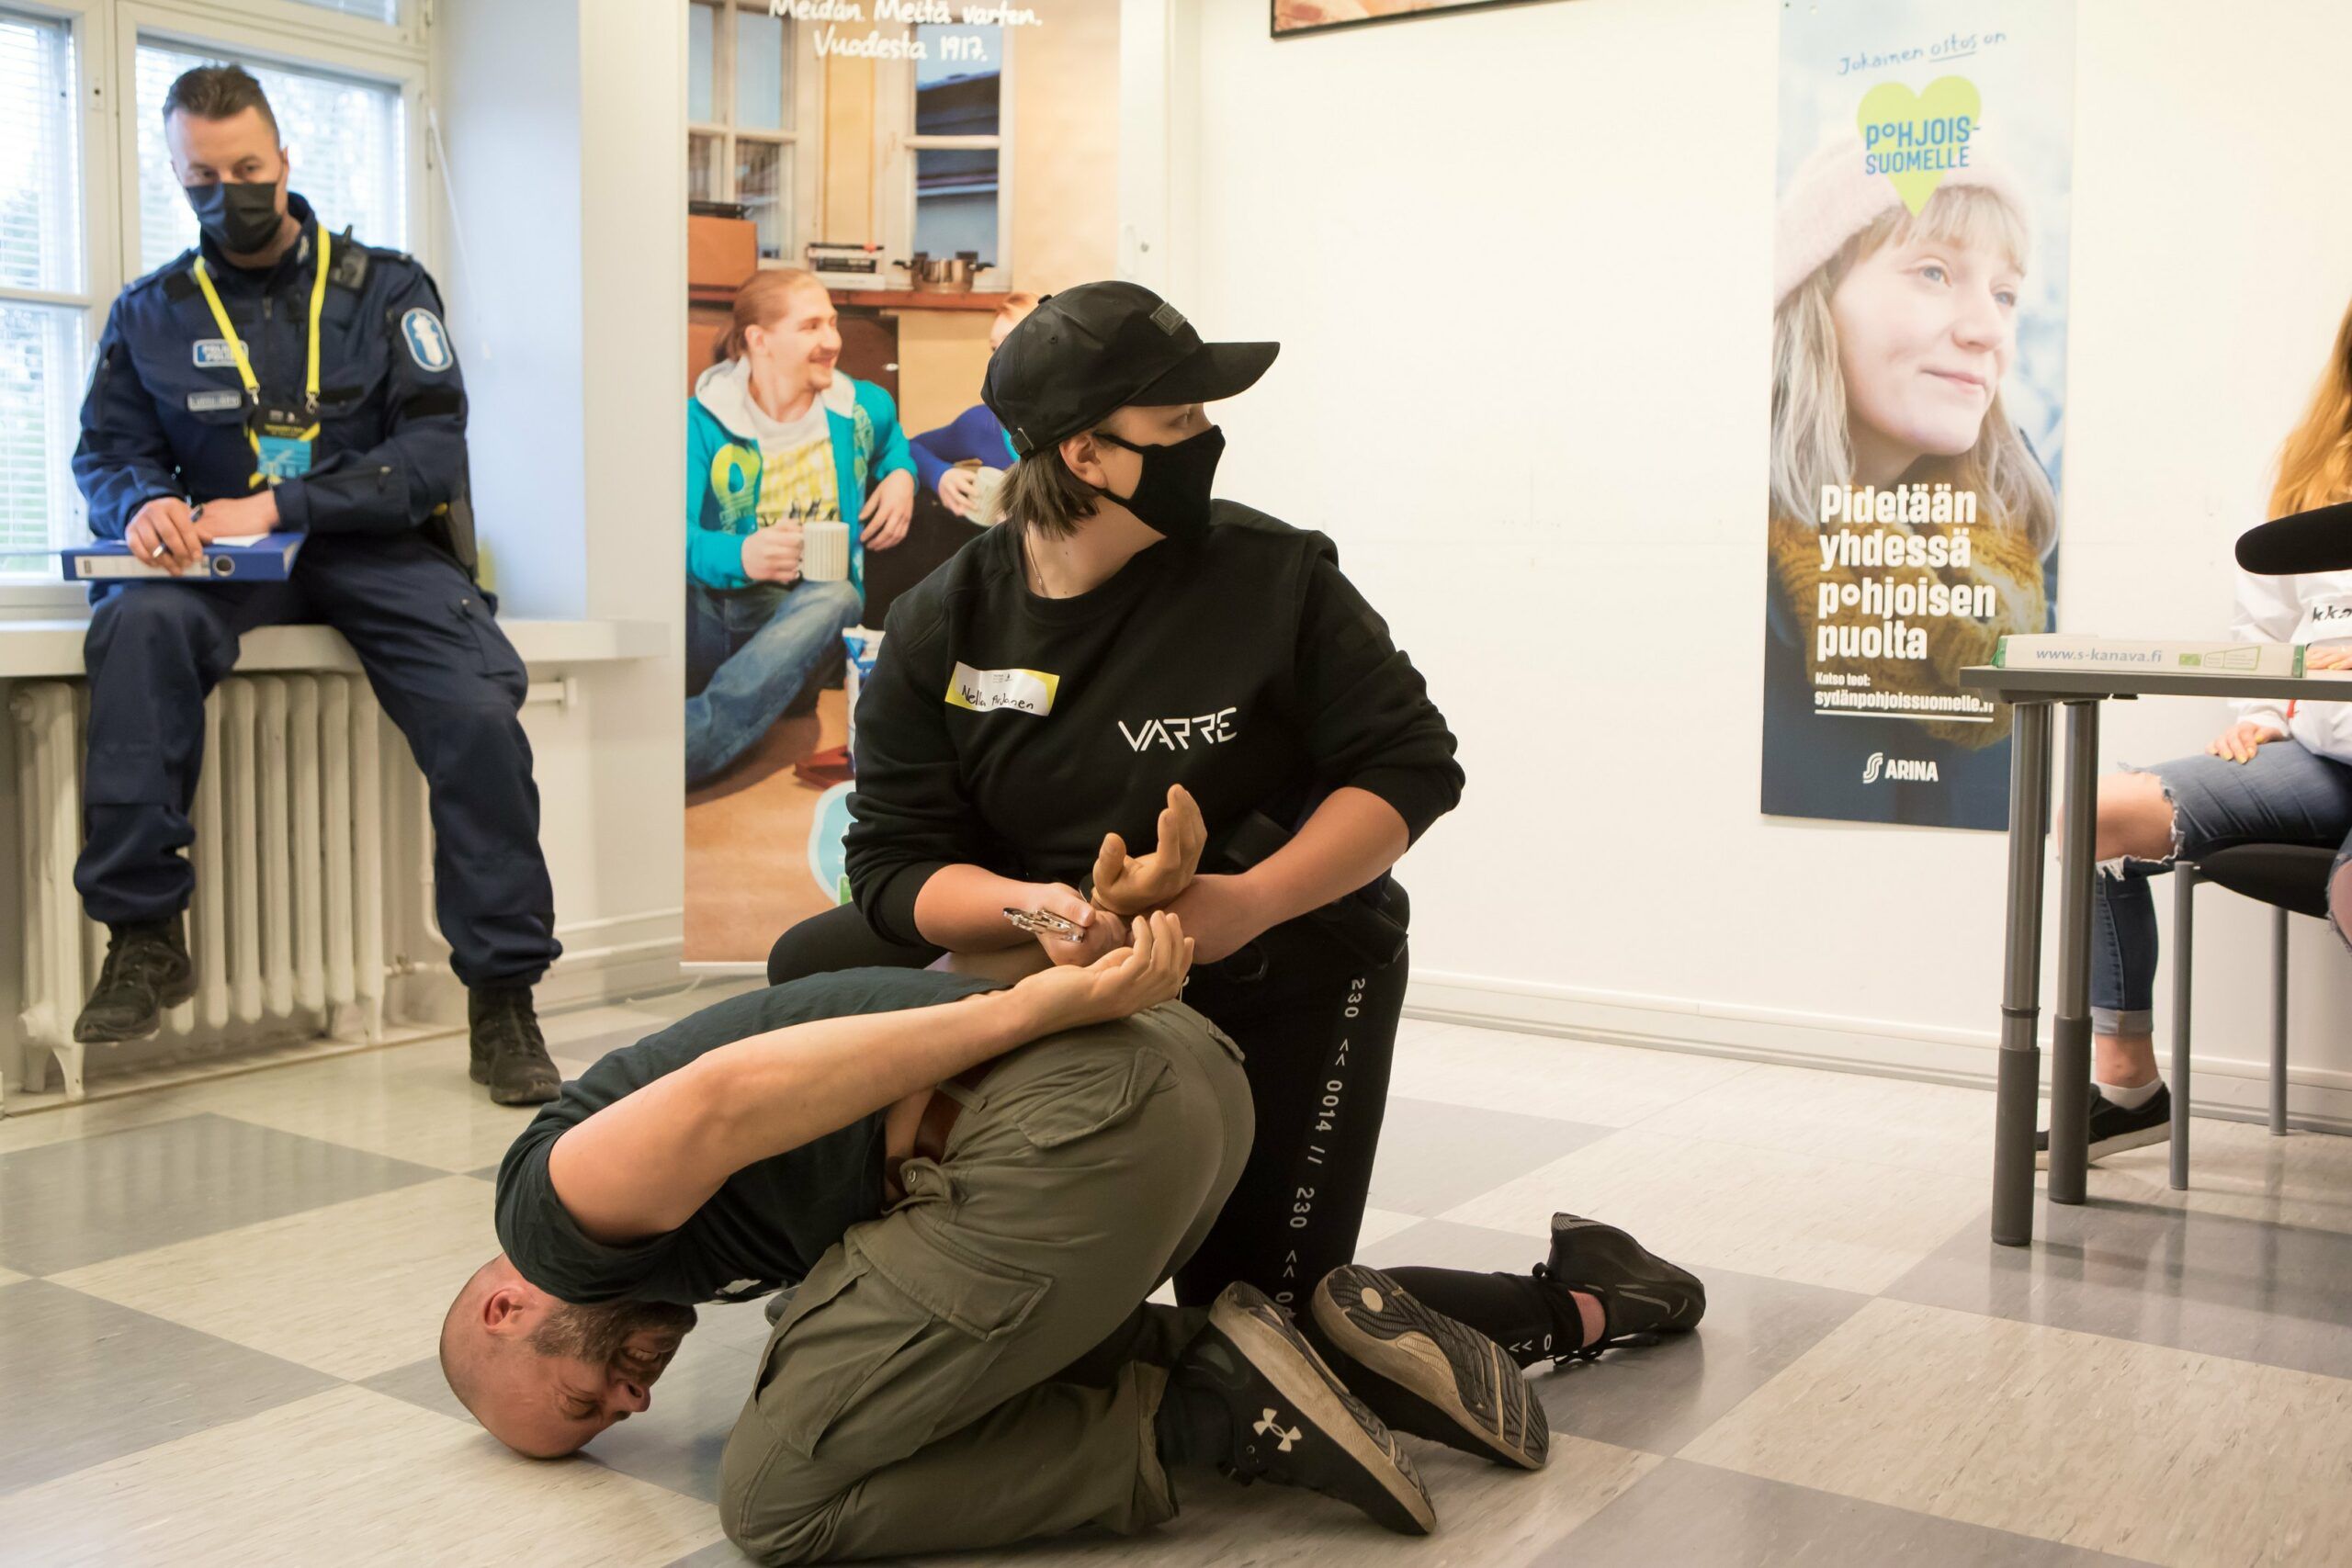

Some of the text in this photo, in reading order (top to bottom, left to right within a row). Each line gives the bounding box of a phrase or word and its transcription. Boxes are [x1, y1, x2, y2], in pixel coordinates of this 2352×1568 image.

[962, 0, 1043, 28] varten.
[813, 25, 989, 62] Vuodesta 1917.
[1930, 33, 1977, 56] ostos
[1983, 31, 2007, 45] on
[1865, 146, 1971, 175] SUOMELLE
[1820, 483, 1976, 524] Pidetään
[1819, 528, 1972, 571] yhdessä
[1817, 576, 1996, 620] pohjoisen
[1816, 620, 1928, 661] puolta
[2036, 648, 2162, 662] www.s-kanava.fi
[961, 684, 987, 706] Nella
[1815, 671, 1871, 687] Katso teot:
[1118, 706, 1238, 752] VARRE
[1884, 759, 1939, 782] ARINA
[1344, 977, 1366, 1019] 230
[1315, 1079, 1343, 1132] 0014
[1289, 1187, 1315, 1229] 230
